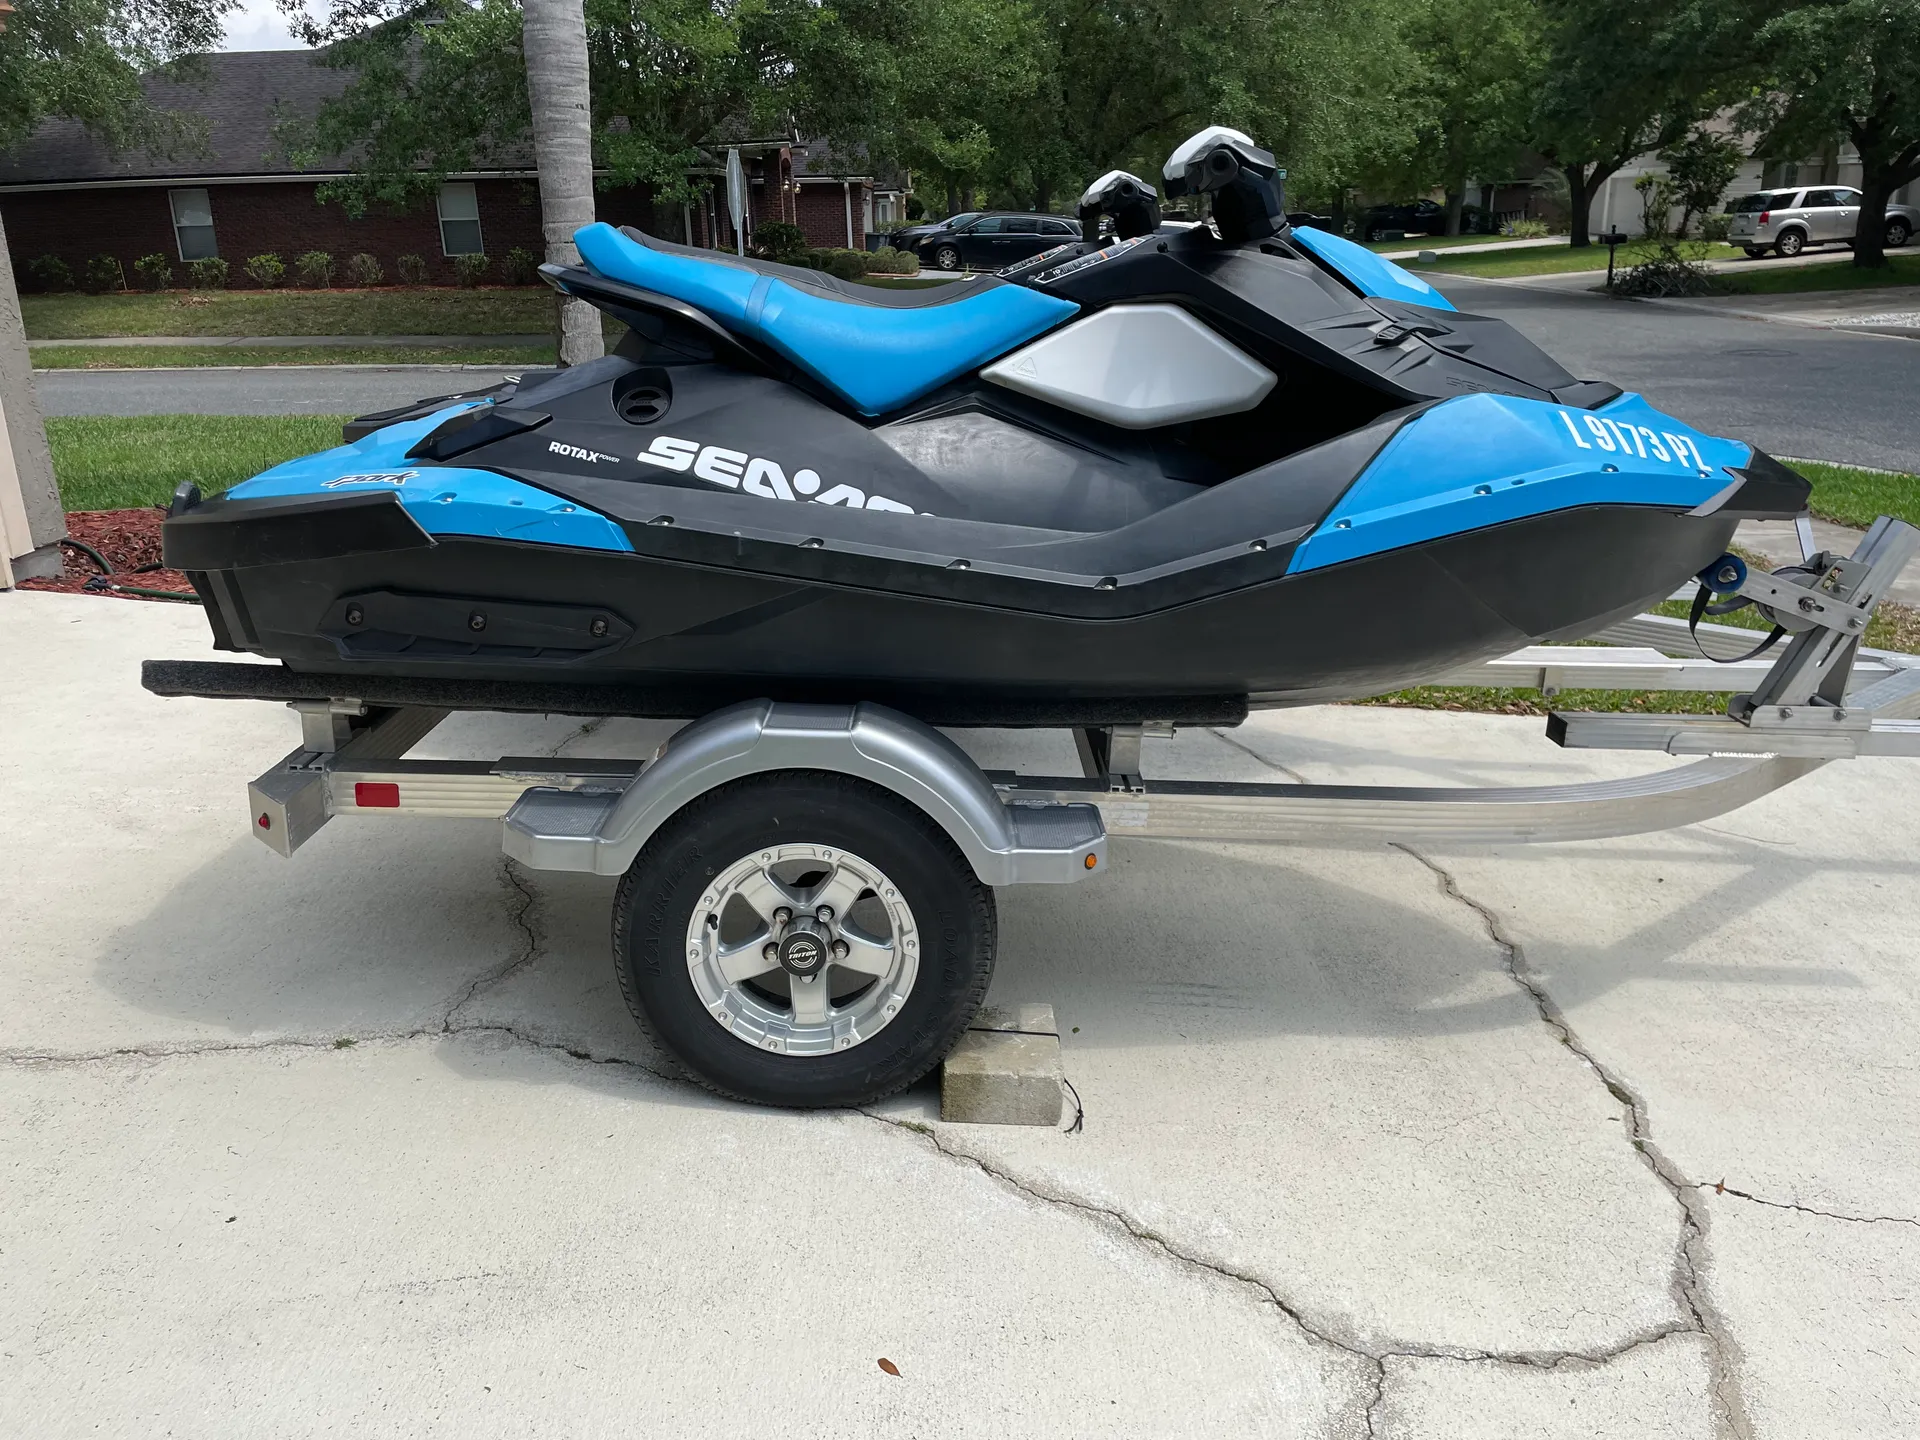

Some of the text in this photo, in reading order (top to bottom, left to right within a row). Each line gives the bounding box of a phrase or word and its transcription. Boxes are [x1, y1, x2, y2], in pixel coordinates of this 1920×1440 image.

[548, 441, 621, 464] ROTAX POWER
[1559, 410, 1714, 473] L 9173 PZ
[645, 845, 702, 976] KARRIER
[788, 950, 817, 960] TRITON
[937, 910, 960, 987] LOAD
